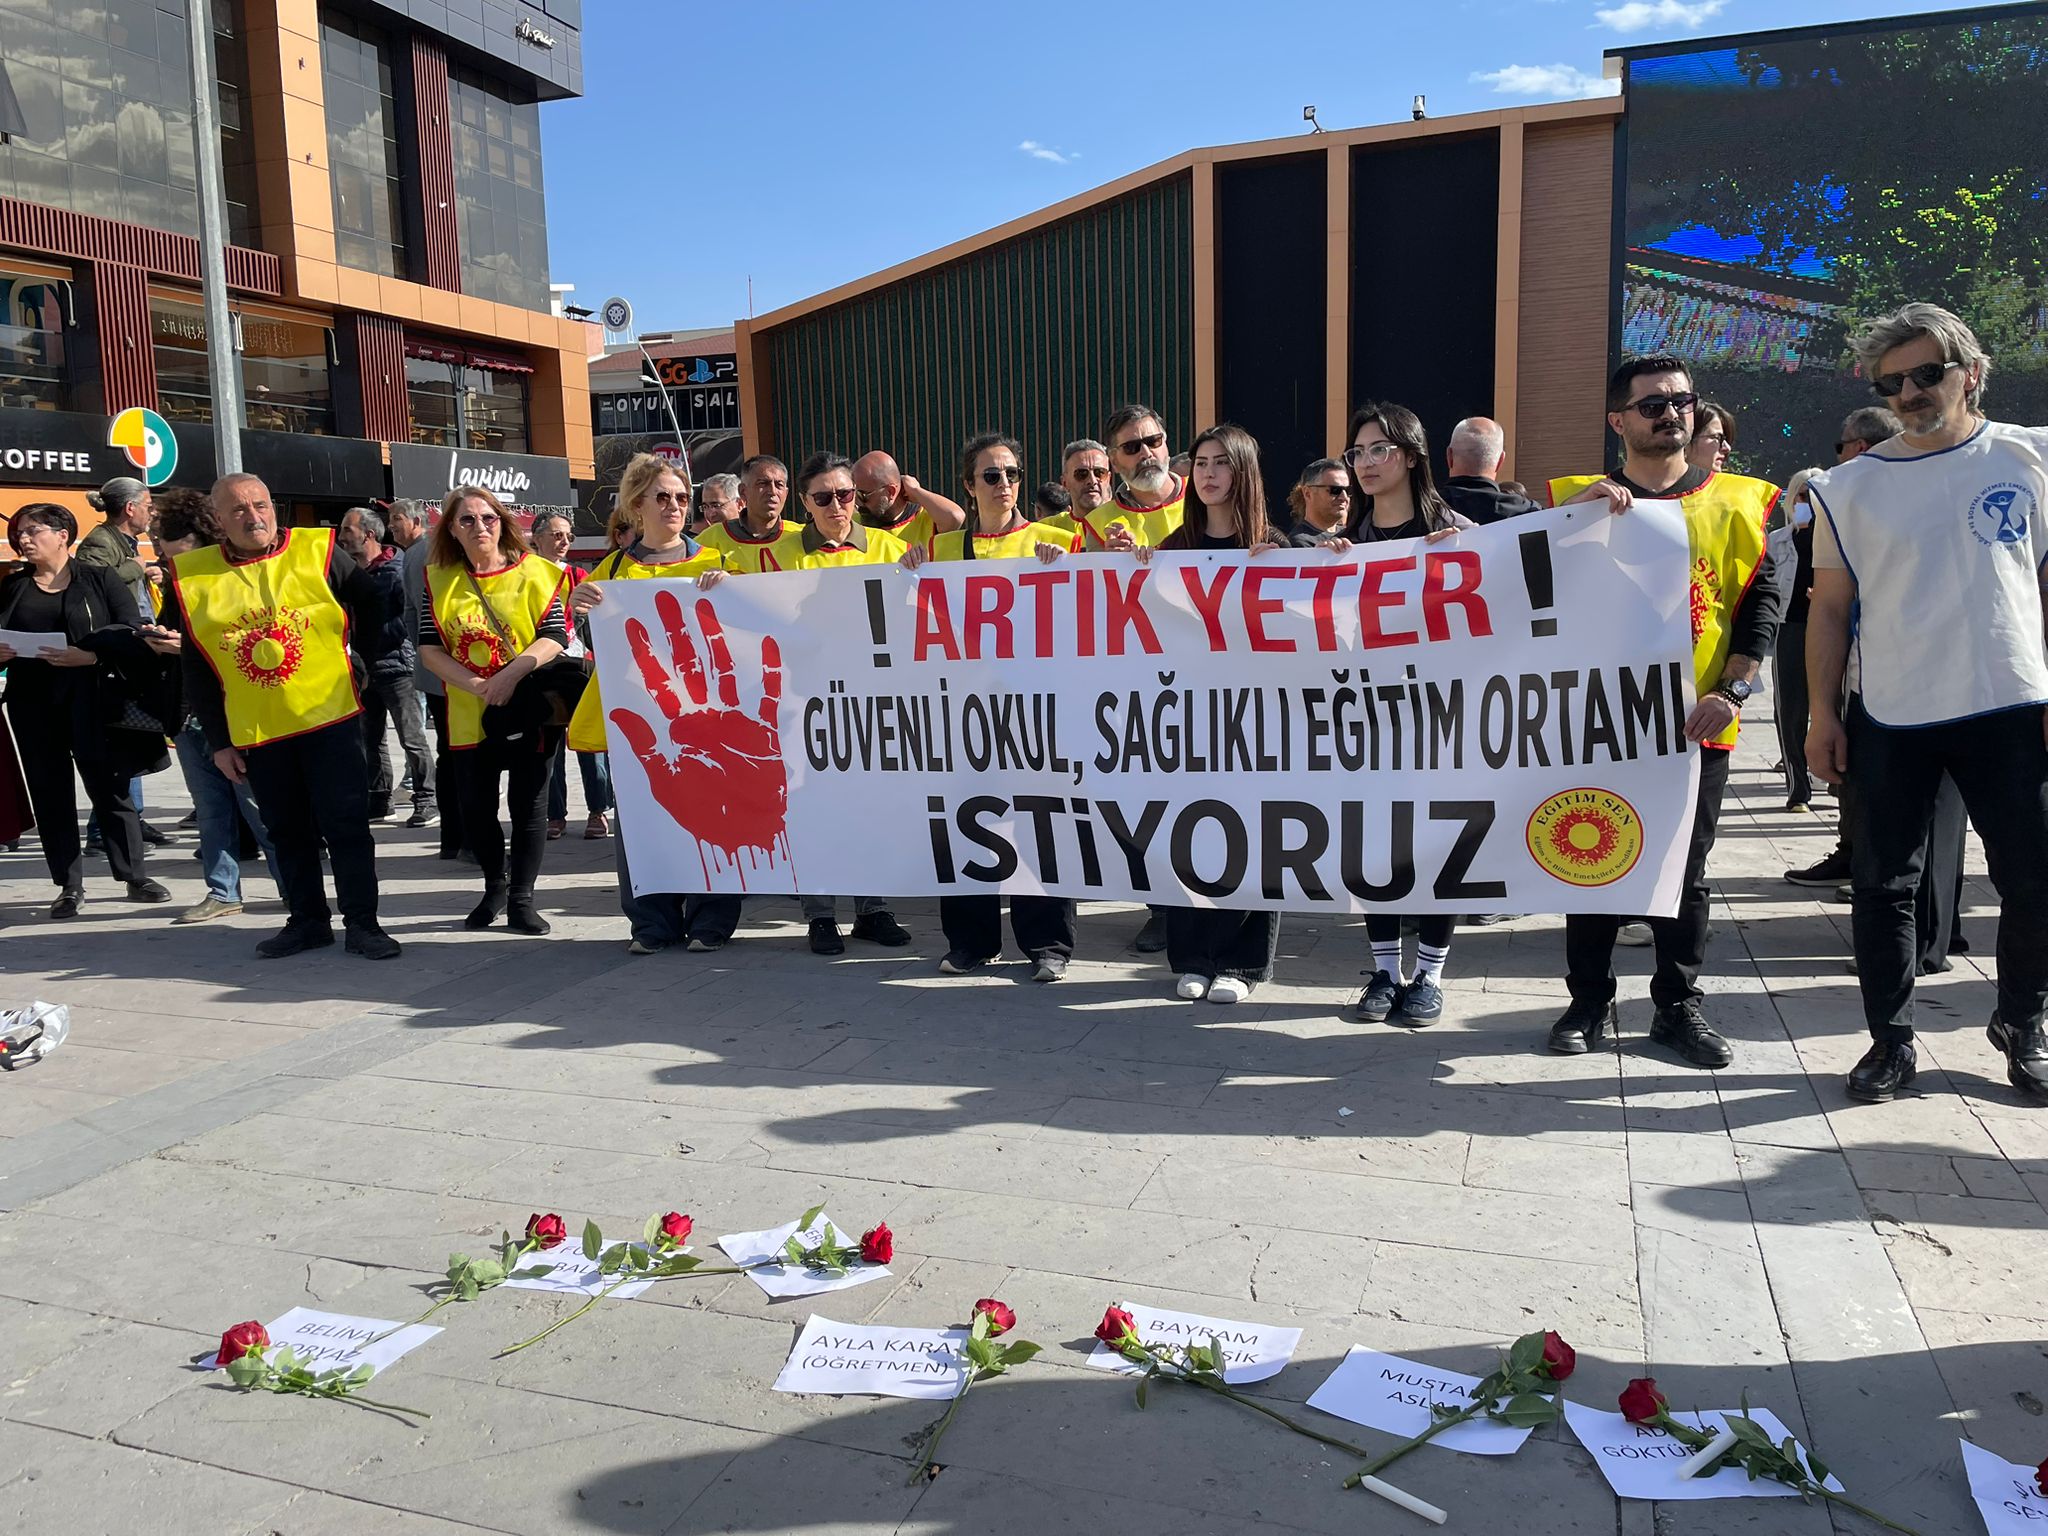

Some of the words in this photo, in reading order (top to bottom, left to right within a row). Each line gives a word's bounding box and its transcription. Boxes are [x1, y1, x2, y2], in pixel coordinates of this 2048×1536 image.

[0, 448, 91, 472] OFFEE
[448, 450, 530, 491] Lavinia
[864, 579, 892, 668] !
[913, 568, 1164, 661] ARTIK
[1179, 550, 1494, 653] YETER
[1518, 529, 1558, 637] !
[803, 678, 954, 773] GÜVENLİ
[961, 692, 1084, 786] OKUL,
[1094, 670, 1291, 774] SAĞLIKLI
[1302, 664, 1463, 772] EĞİTİM
[1479, 661, 1688, 770] ORTAMI
[1536, 791, 1596, 826] EĞİTİM
[1602, 798, 1634, 826] SEN
[811, 1335, 875, 1351] AYLA
[884, 1339, 951, 1355] KARA
[1149, 1320, 1259, 1345] BAYRAM
[801, 1355, 949, 1376] (ÖĞRETMEN)
[1380, 1368, 1474, 1398] MUSTA
